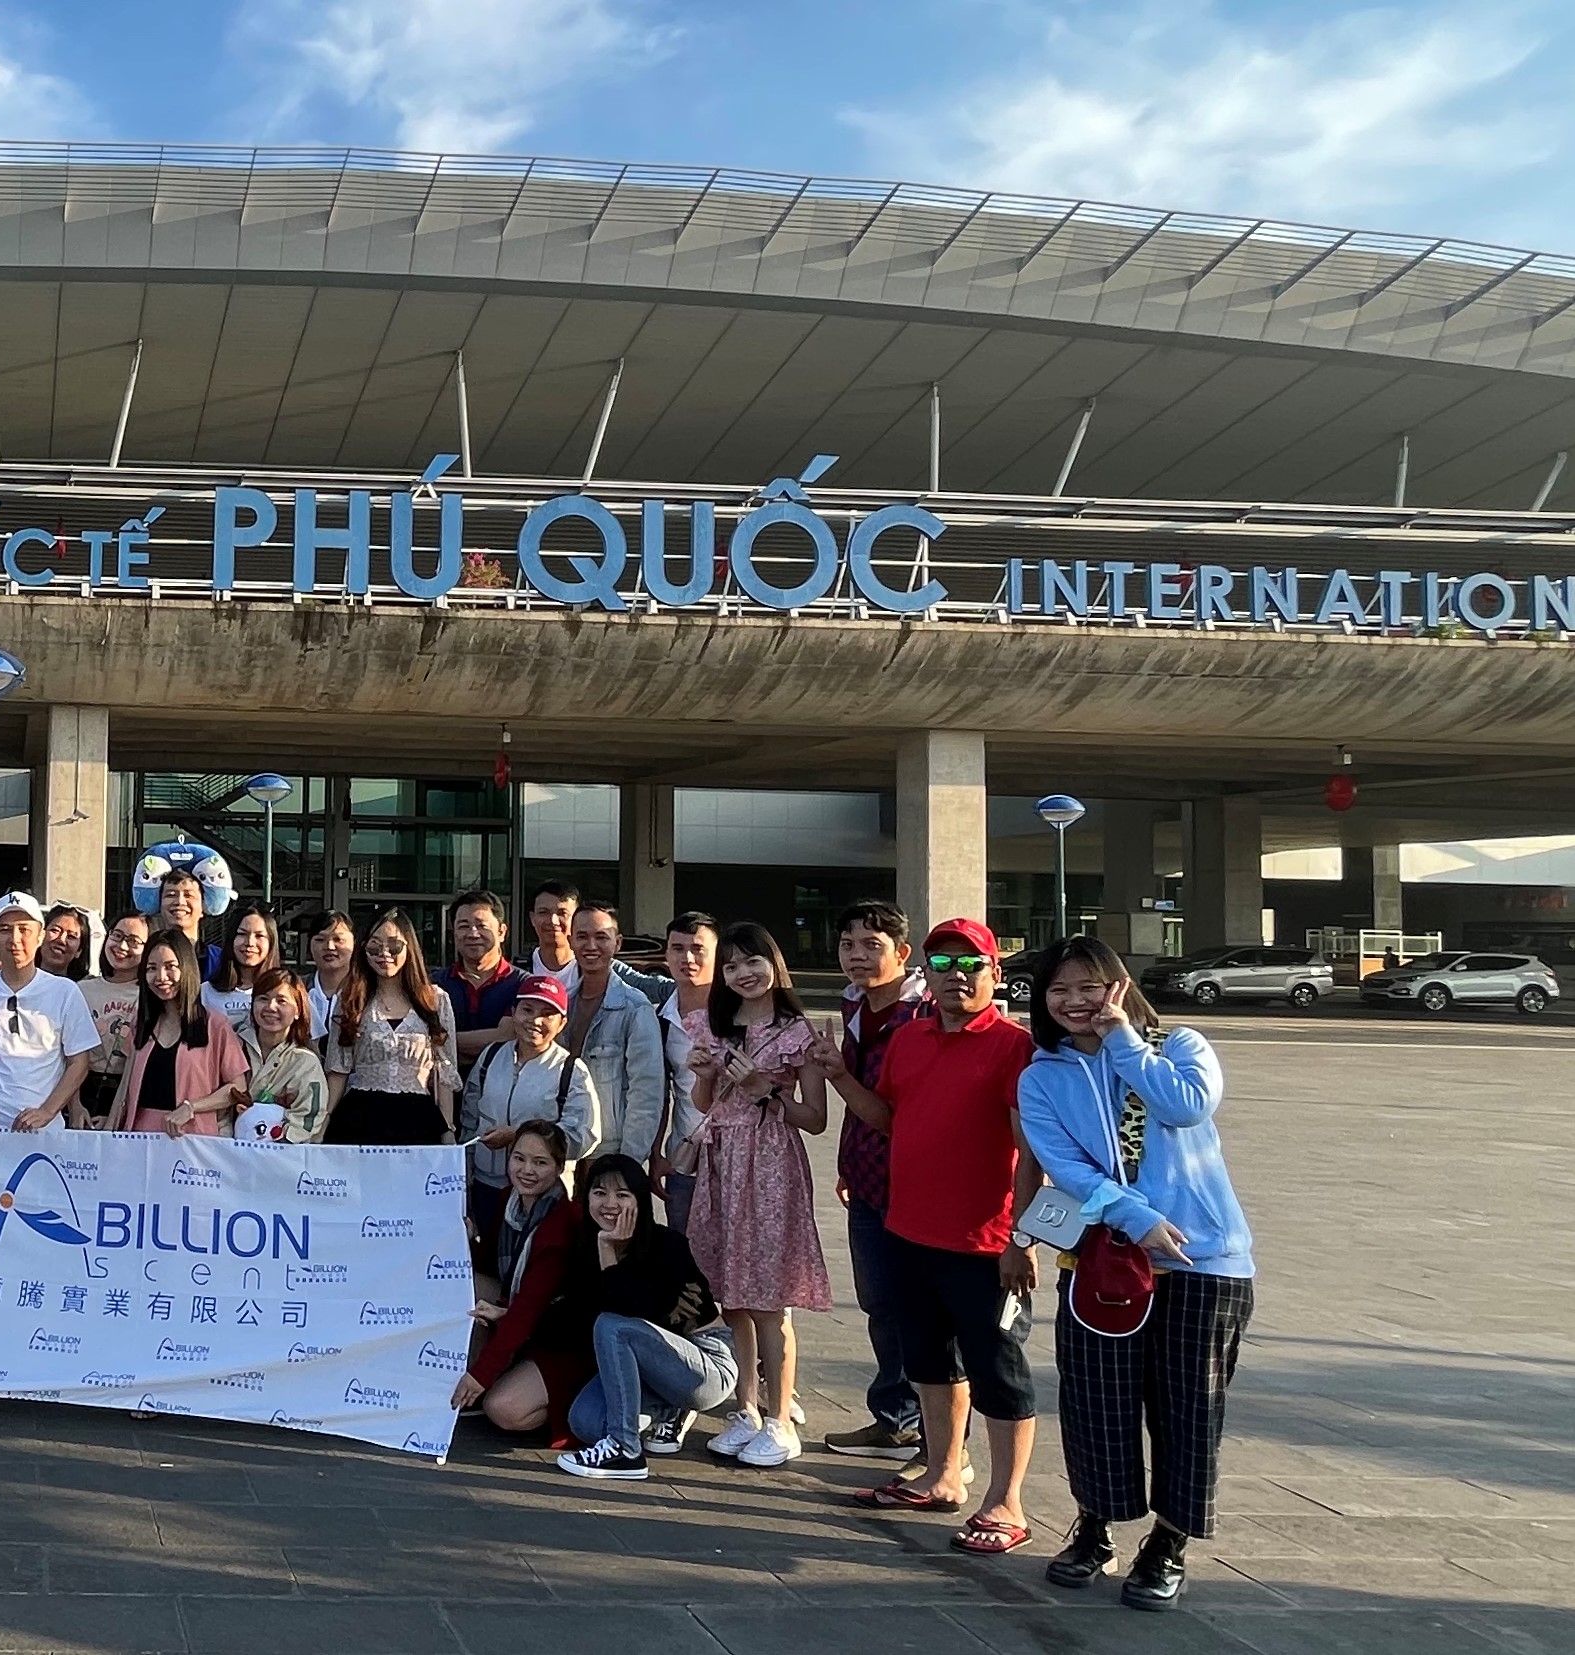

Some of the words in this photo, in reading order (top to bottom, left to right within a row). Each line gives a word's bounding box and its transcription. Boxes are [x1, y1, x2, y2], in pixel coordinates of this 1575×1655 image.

[81, 506, 167, 587] TẾ
[212, 453, 463, 600] PHÚ
[517, 453, 949, 612] QUỐC
